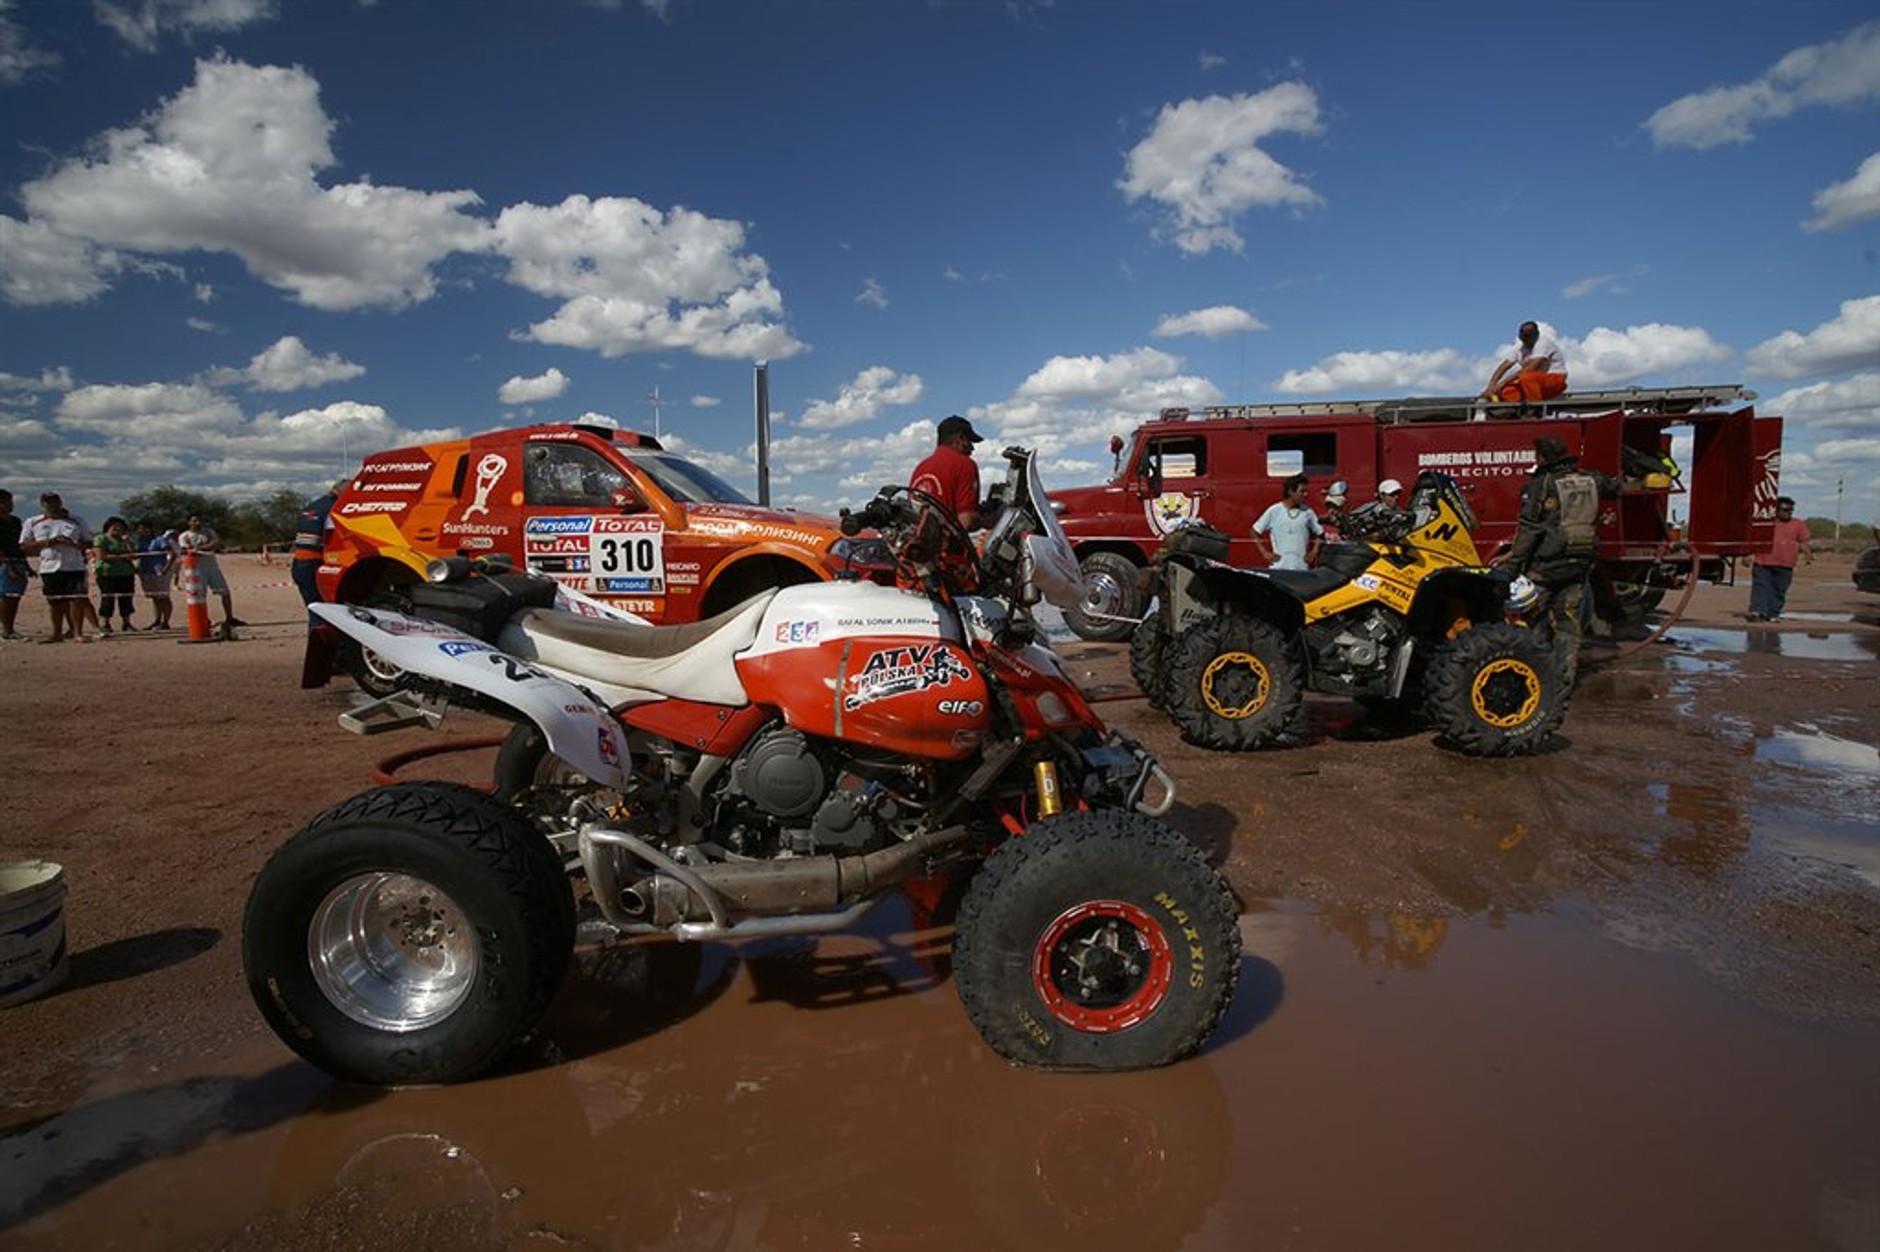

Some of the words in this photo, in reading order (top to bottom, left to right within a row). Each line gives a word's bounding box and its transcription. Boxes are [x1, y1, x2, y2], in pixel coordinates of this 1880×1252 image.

[1418, 453, 1473, 466] BOMBEROS
[442, 522, 509, 535] SunHunters
[528, 518, 591, 532] Personal
[597, 520, 660, 532] TOTAL
[532, 538, 588, 551] TOTAL
[601, 539, 654, 572] 310
[609, 579, 649, 589] Personal
[614, 600, 655, 613] STEYR
[863, 645, 931, 676] ATV
[861, 666, 916, 687] POLSKA
[938, 701, 968, 714] elf
[1154, 891, 1206, 989] MAXXIS
